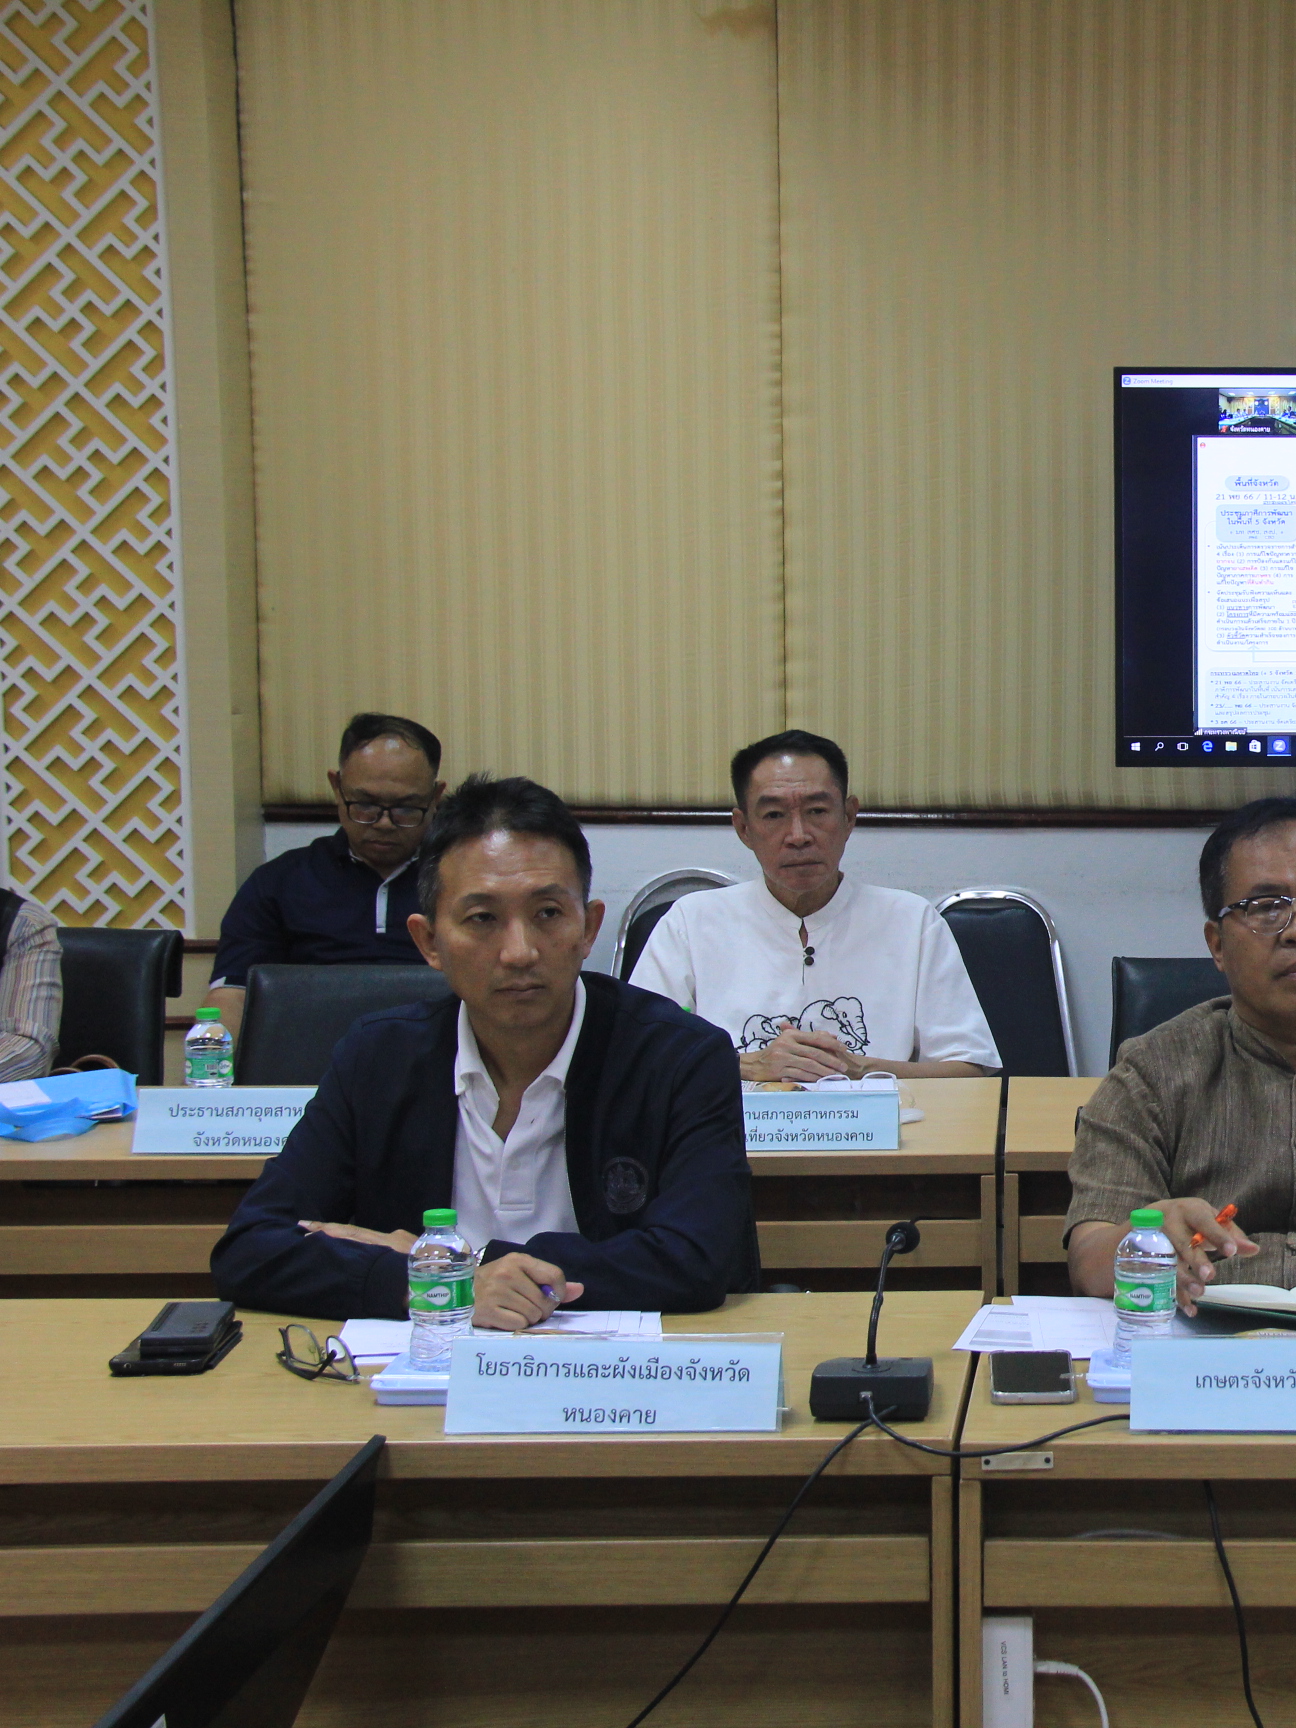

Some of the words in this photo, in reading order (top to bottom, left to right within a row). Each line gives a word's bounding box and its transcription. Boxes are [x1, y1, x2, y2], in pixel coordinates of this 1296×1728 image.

[169, 1104, 306, 1121] ประธานสภาอุตสาห
[744, 1109, 859, 1124] านสภาอุตสาหกรรม
[476, 1352, 750, 1382] โยธาธิการและผังเมืองจังหวัด
[563, 1407, 657, 1425] หนองคาย
